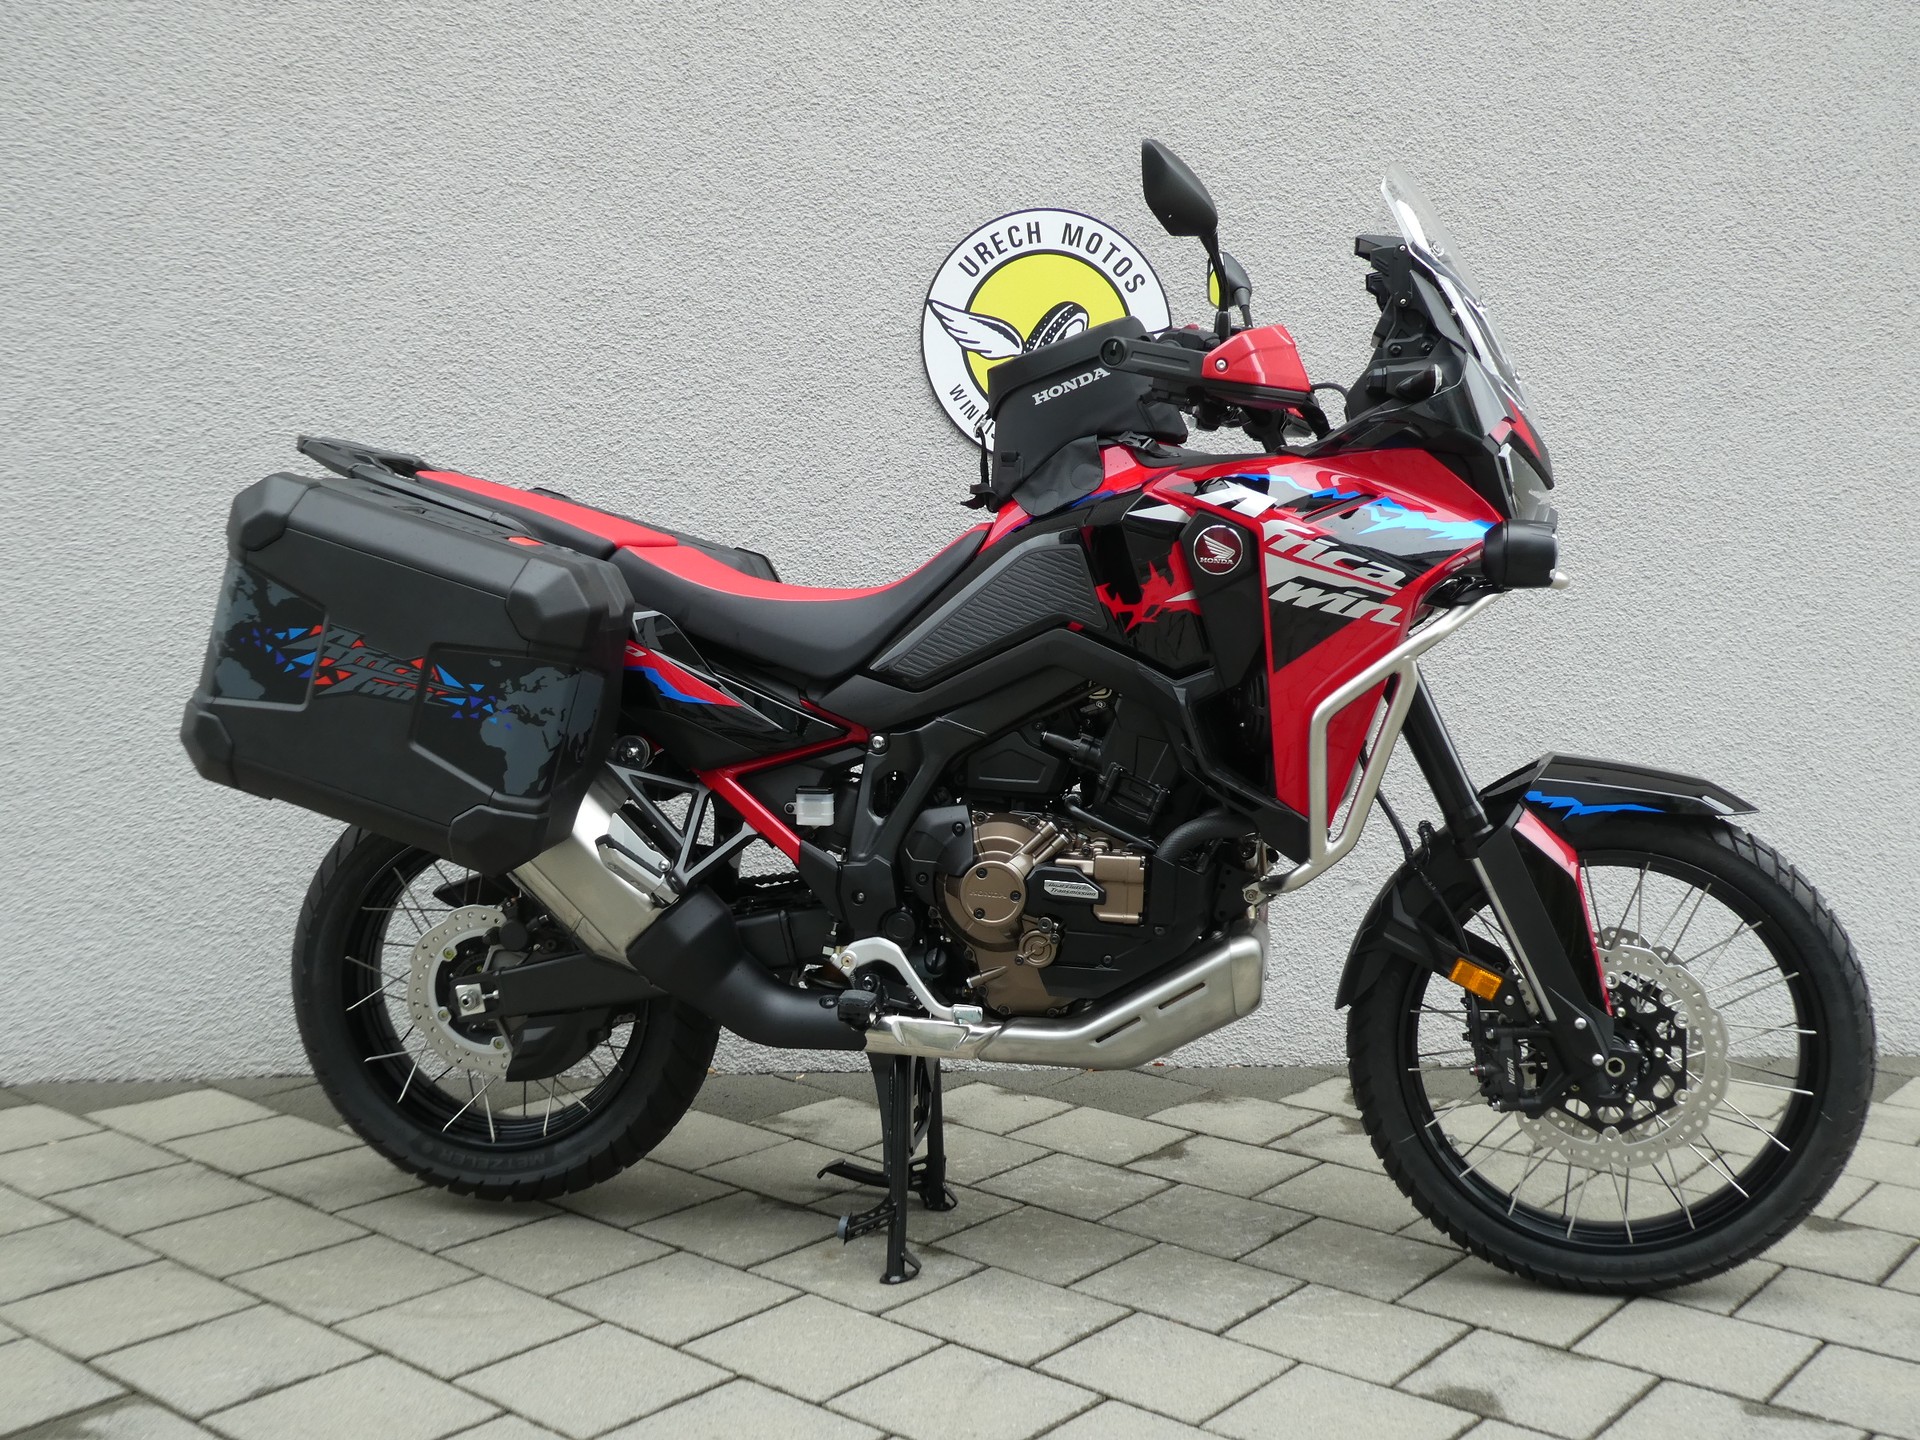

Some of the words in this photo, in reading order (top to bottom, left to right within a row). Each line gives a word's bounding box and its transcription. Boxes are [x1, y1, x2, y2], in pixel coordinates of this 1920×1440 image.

[957, 221, 1042, 278] URECH
[1061, 222, 1146, 294] MOTOS
[1031, 367, 1111, 406] HONDA
[1200, 556, 1235, 565] HONDA
[968, 888, 1008, 900] HONDA
[1050, 887, 1097, 897] Transmission
[438, 1147, 546, 1172] METZELER
